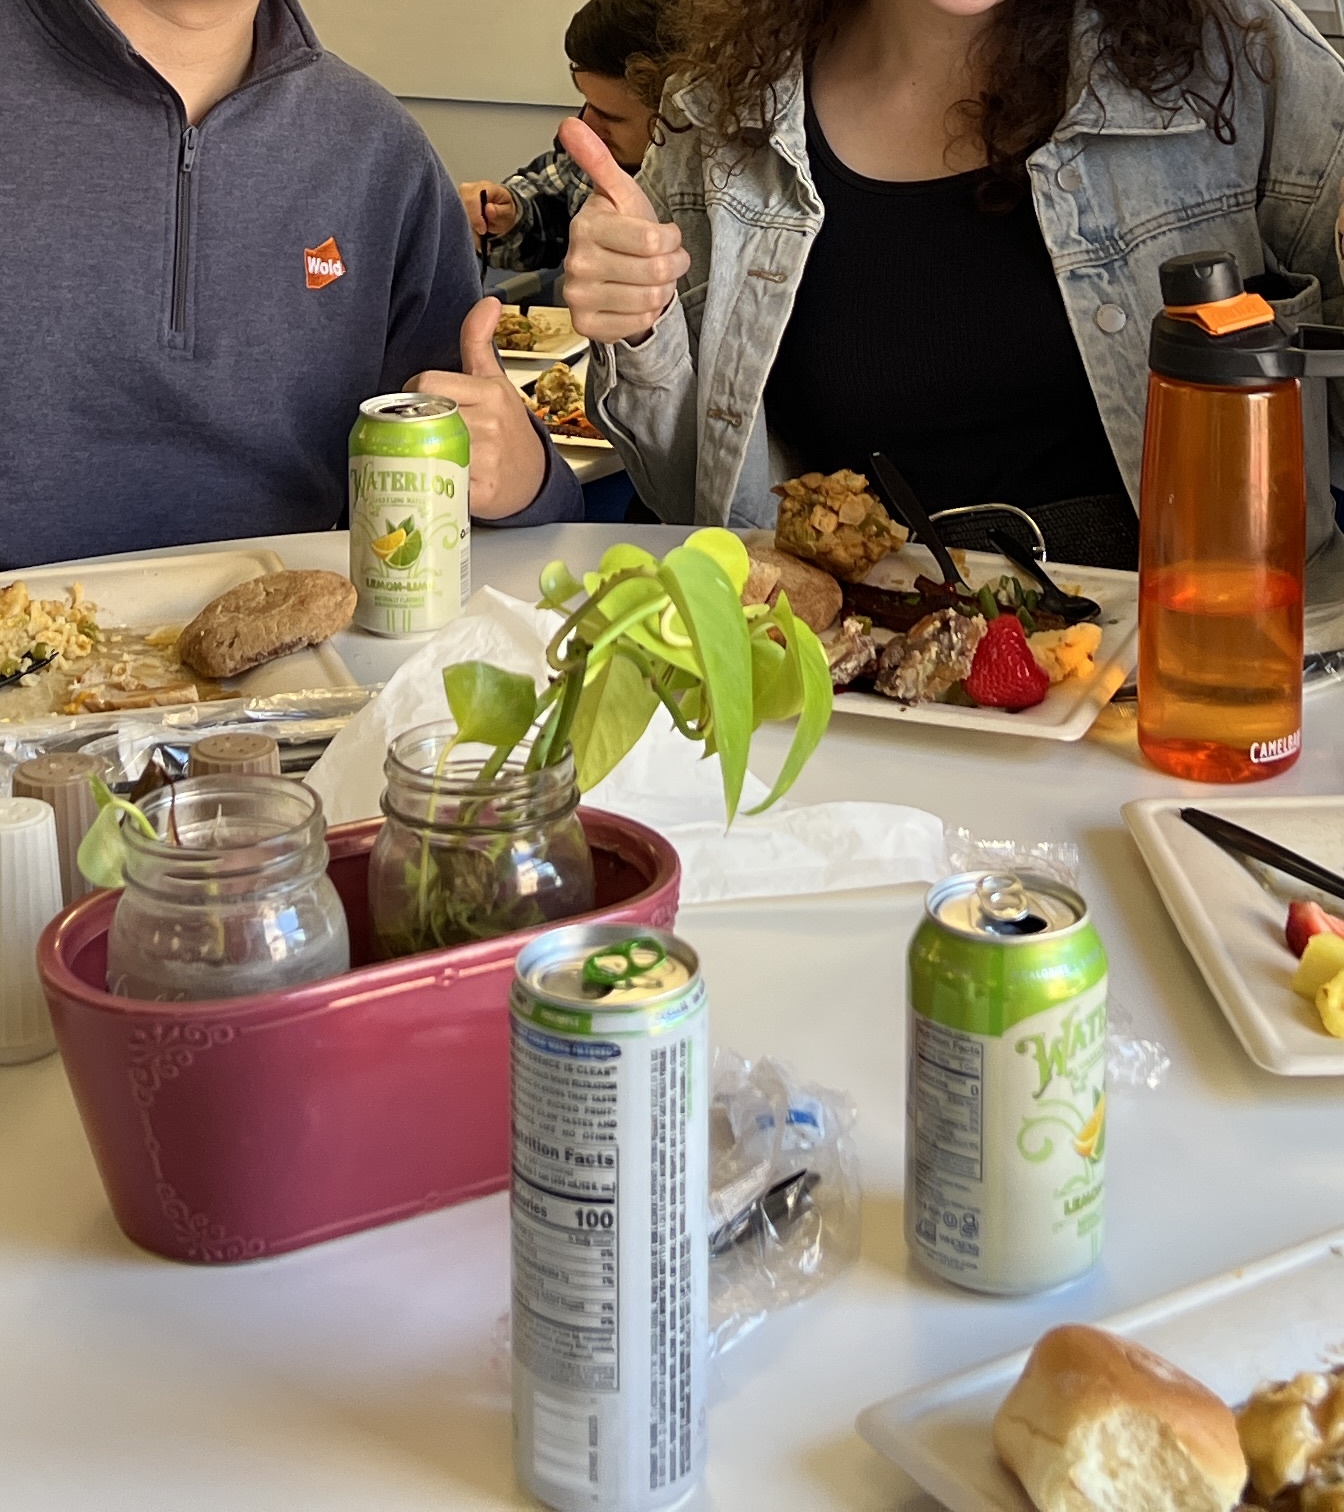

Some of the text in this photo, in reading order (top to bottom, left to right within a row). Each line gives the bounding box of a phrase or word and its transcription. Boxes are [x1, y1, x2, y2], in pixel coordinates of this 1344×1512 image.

[350, 463, 455, 508] WATERLOO
[564, 1145, 615, 1166] Facts
[574, 1207, 615, 1229] 100
